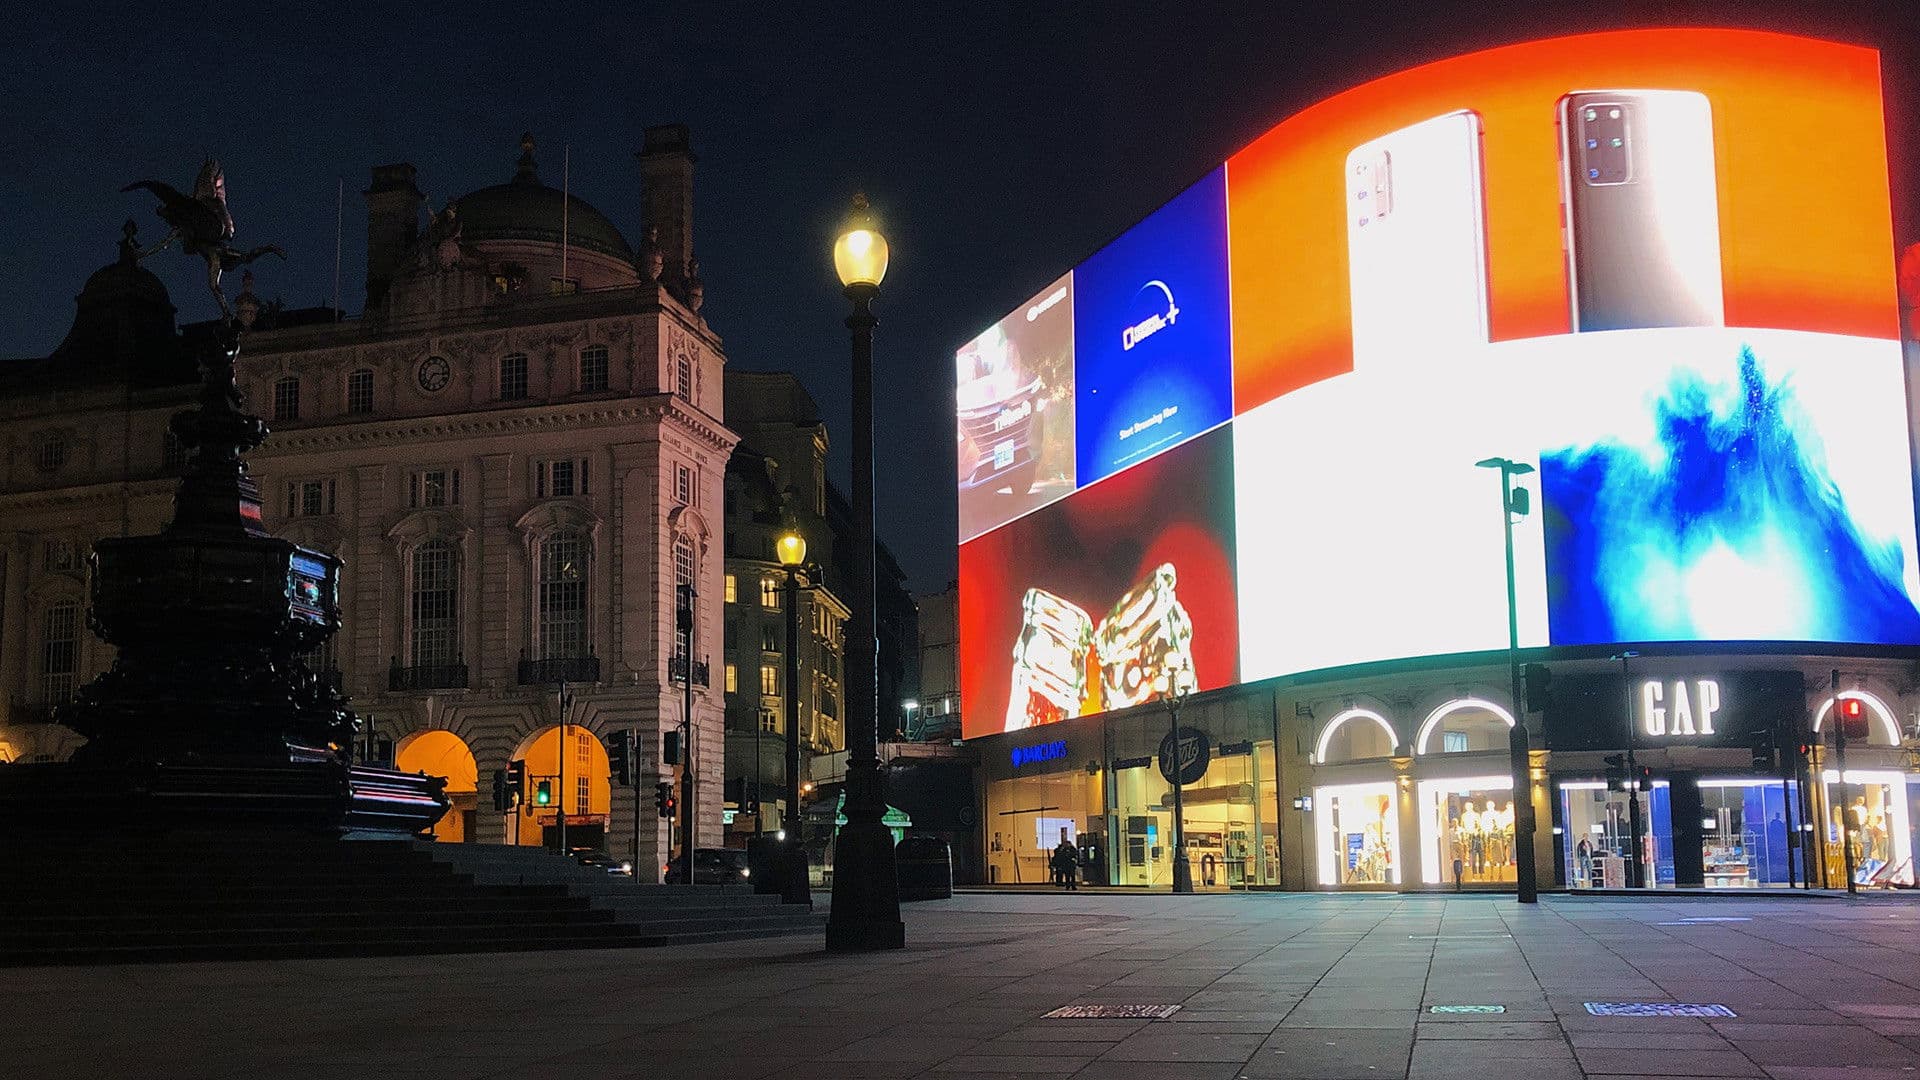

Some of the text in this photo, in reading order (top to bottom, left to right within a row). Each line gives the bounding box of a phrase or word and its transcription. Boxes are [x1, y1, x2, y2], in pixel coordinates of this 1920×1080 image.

[1119, 427, 1134, 441] Start
[1134, 413, 1163, 434] Streaming
[1643, 680, 1720, 736] GAP
[1022, 739, 1068, 765] BARCLAYS
